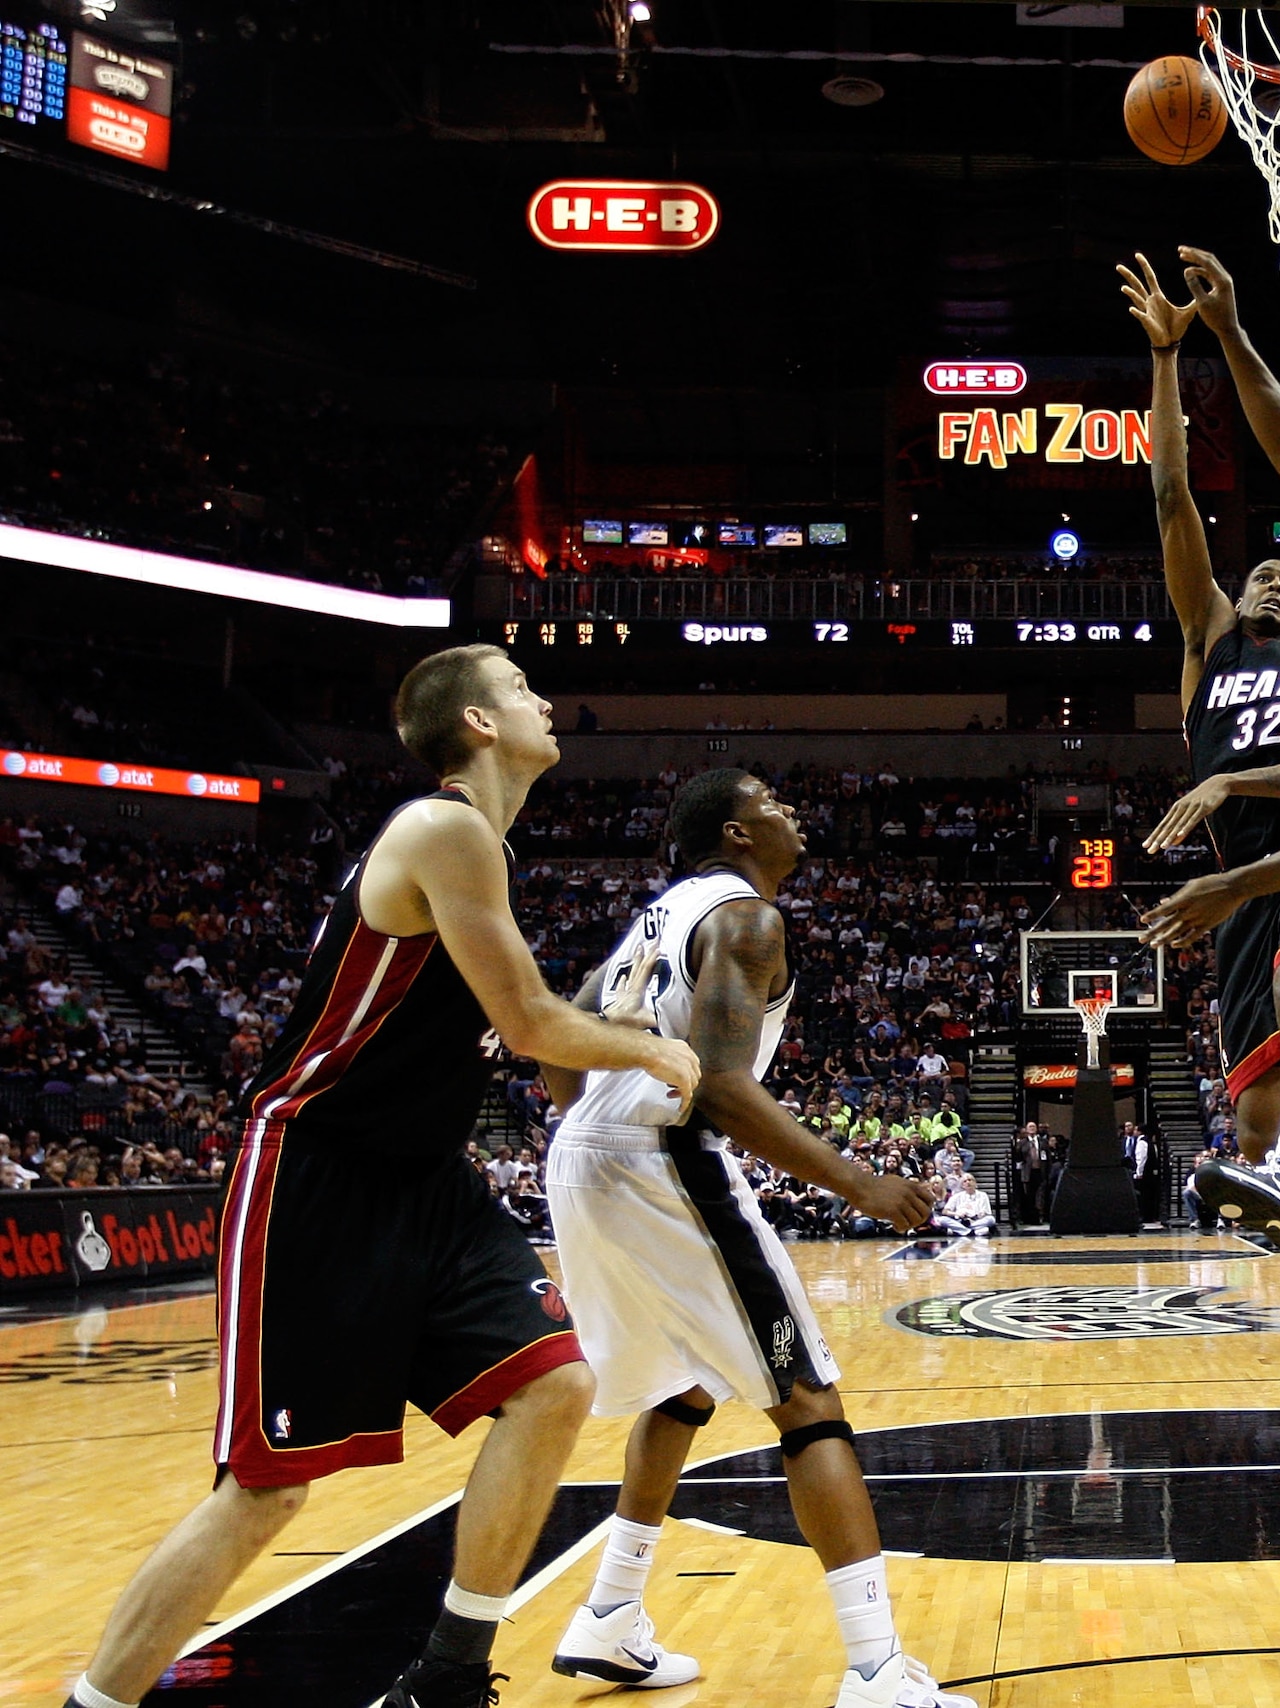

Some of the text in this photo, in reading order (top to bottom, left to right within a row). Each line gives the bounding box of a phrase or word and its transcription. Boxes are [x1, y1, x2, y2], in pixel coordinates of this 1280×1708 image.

[552, 197, 699, 232] H-E-B
[935, 368, 1018, 387] H-E-B
[939, 404, 1189, 469] FAN ZON
[505, 624, 519, 634] ST
[541, 624, 556, 634] AS
[578, 624, 593, 635] RB
[616, 624, 631, 635] BL
[684, 623, 767, 645] Spurs
[815, 624, 848, 641] 72
[952, 623, 974, 634] TOL
[1017, 624, 1076, 641] 7:33
[1088, 626, 1121, 640] QTR
[1134, 624, 1152, 641] 4
[507, 634, 515, 644] 4
[541, 635, 555, 645] 18
[620, 635, 627, 645] 7
[952, 634, 973, 645] 3:1
[1063, 739, 1082, 750] 114
[28, 759, 240, 796] at&t at&t at&t
[119, 804, 141, 817] 112
[1080, 840, 1113, 857] 7:33
[1072, 856, 1112, 888] 23
